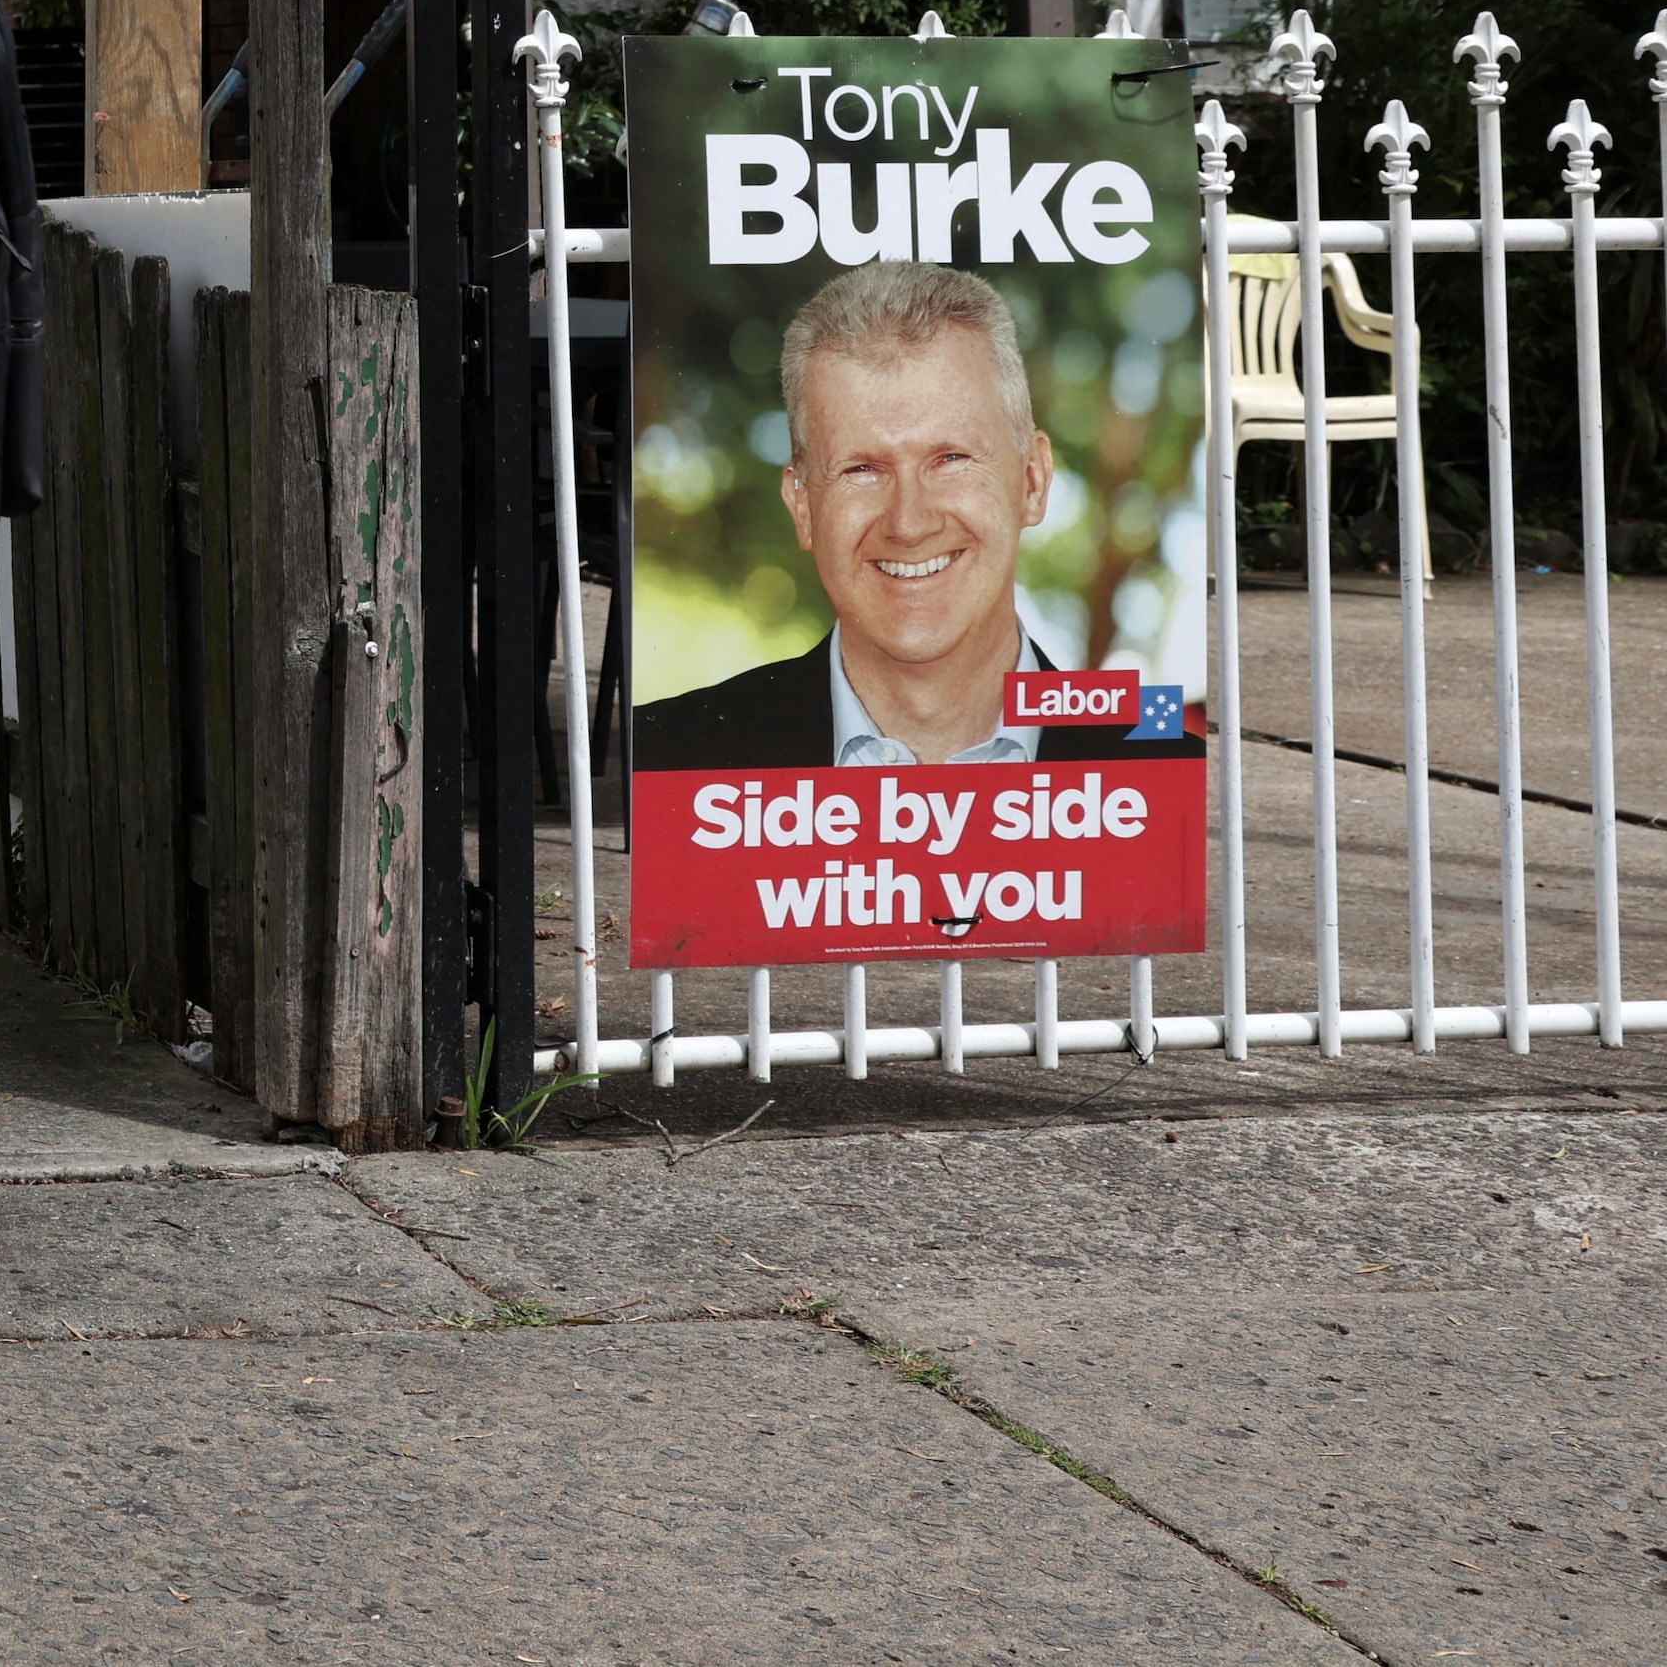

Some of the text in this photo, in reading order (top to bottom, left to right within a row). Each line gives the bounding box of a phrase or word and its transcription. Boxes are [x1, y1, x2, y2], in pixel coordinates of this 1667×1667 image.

[777, 67, 979, 157] Tony
[705, 128, 1154, 266] Burke
[1016, 680, 1127, 717] Labor
[690, 772, 1149, 856] Side by side
[755, 858, 1083, 937] with you
